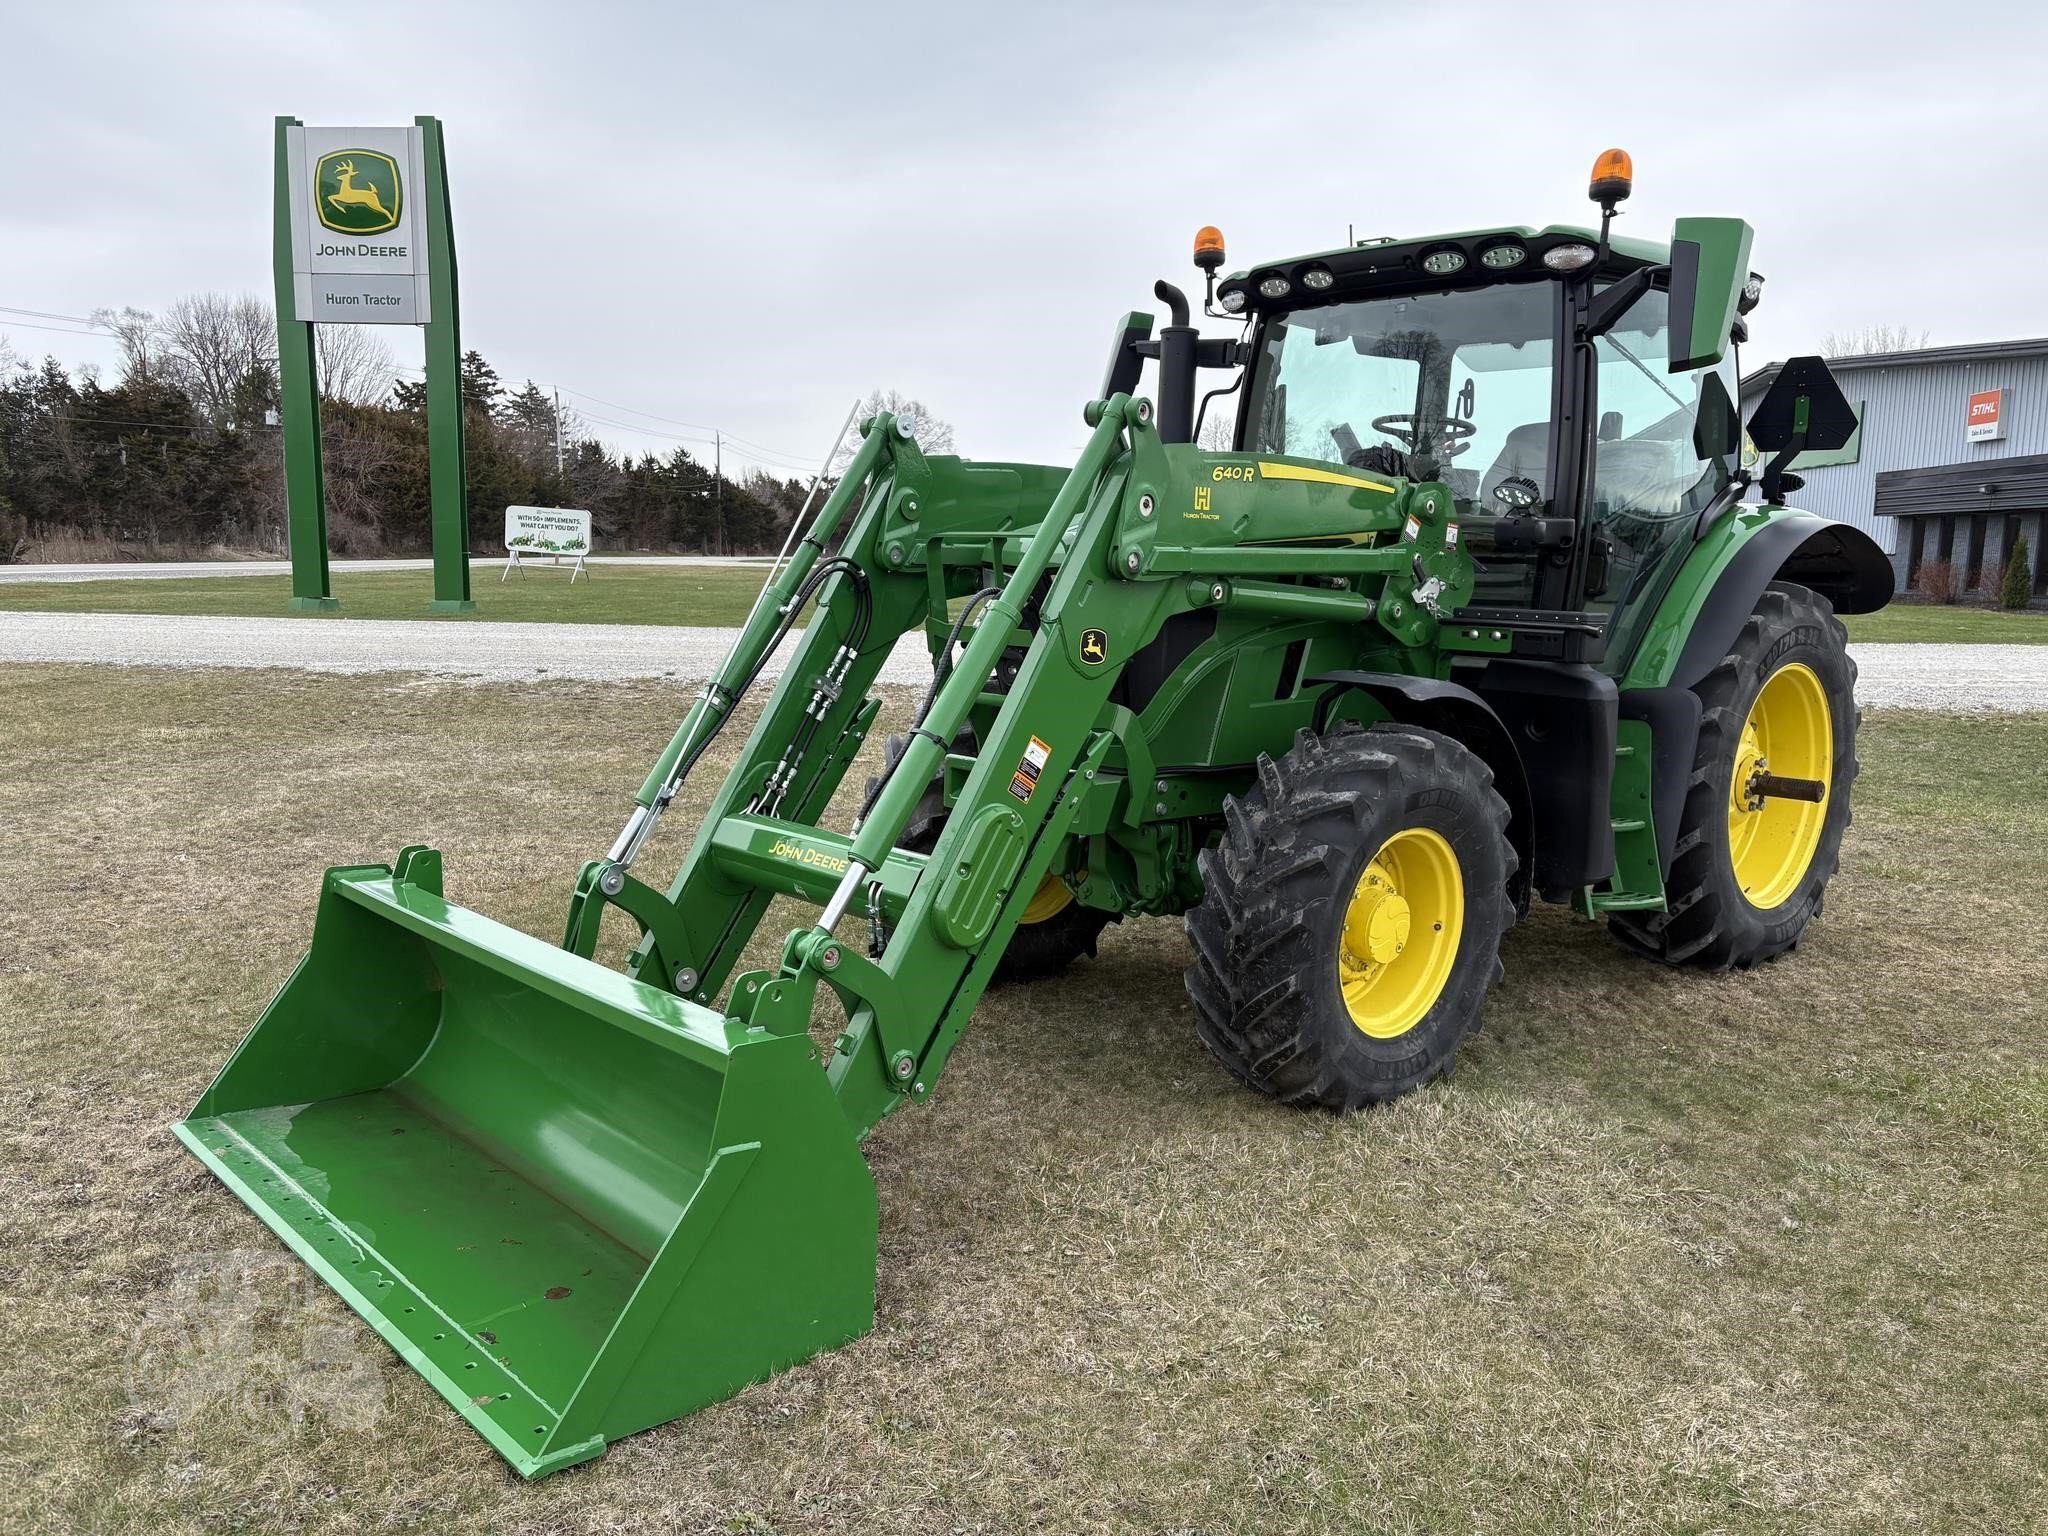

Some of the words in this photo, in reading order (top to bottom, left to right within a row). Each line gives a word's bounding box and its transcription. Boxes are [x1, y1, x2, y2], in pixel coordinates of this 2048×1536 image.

[316, 243, 356, 256] JOHN
[358, 244, 407, 257] DEERE
[326, 293, 359, 304] Huron
[363, 294, 401, 305] Tractor
[1971, 402, 1996, 417] STIHL
[544, 516, 582, 525] IMPLEMENTS,
[768, 839, 804, 860] JOHN
[803, 848, 849, 873] DEERE
